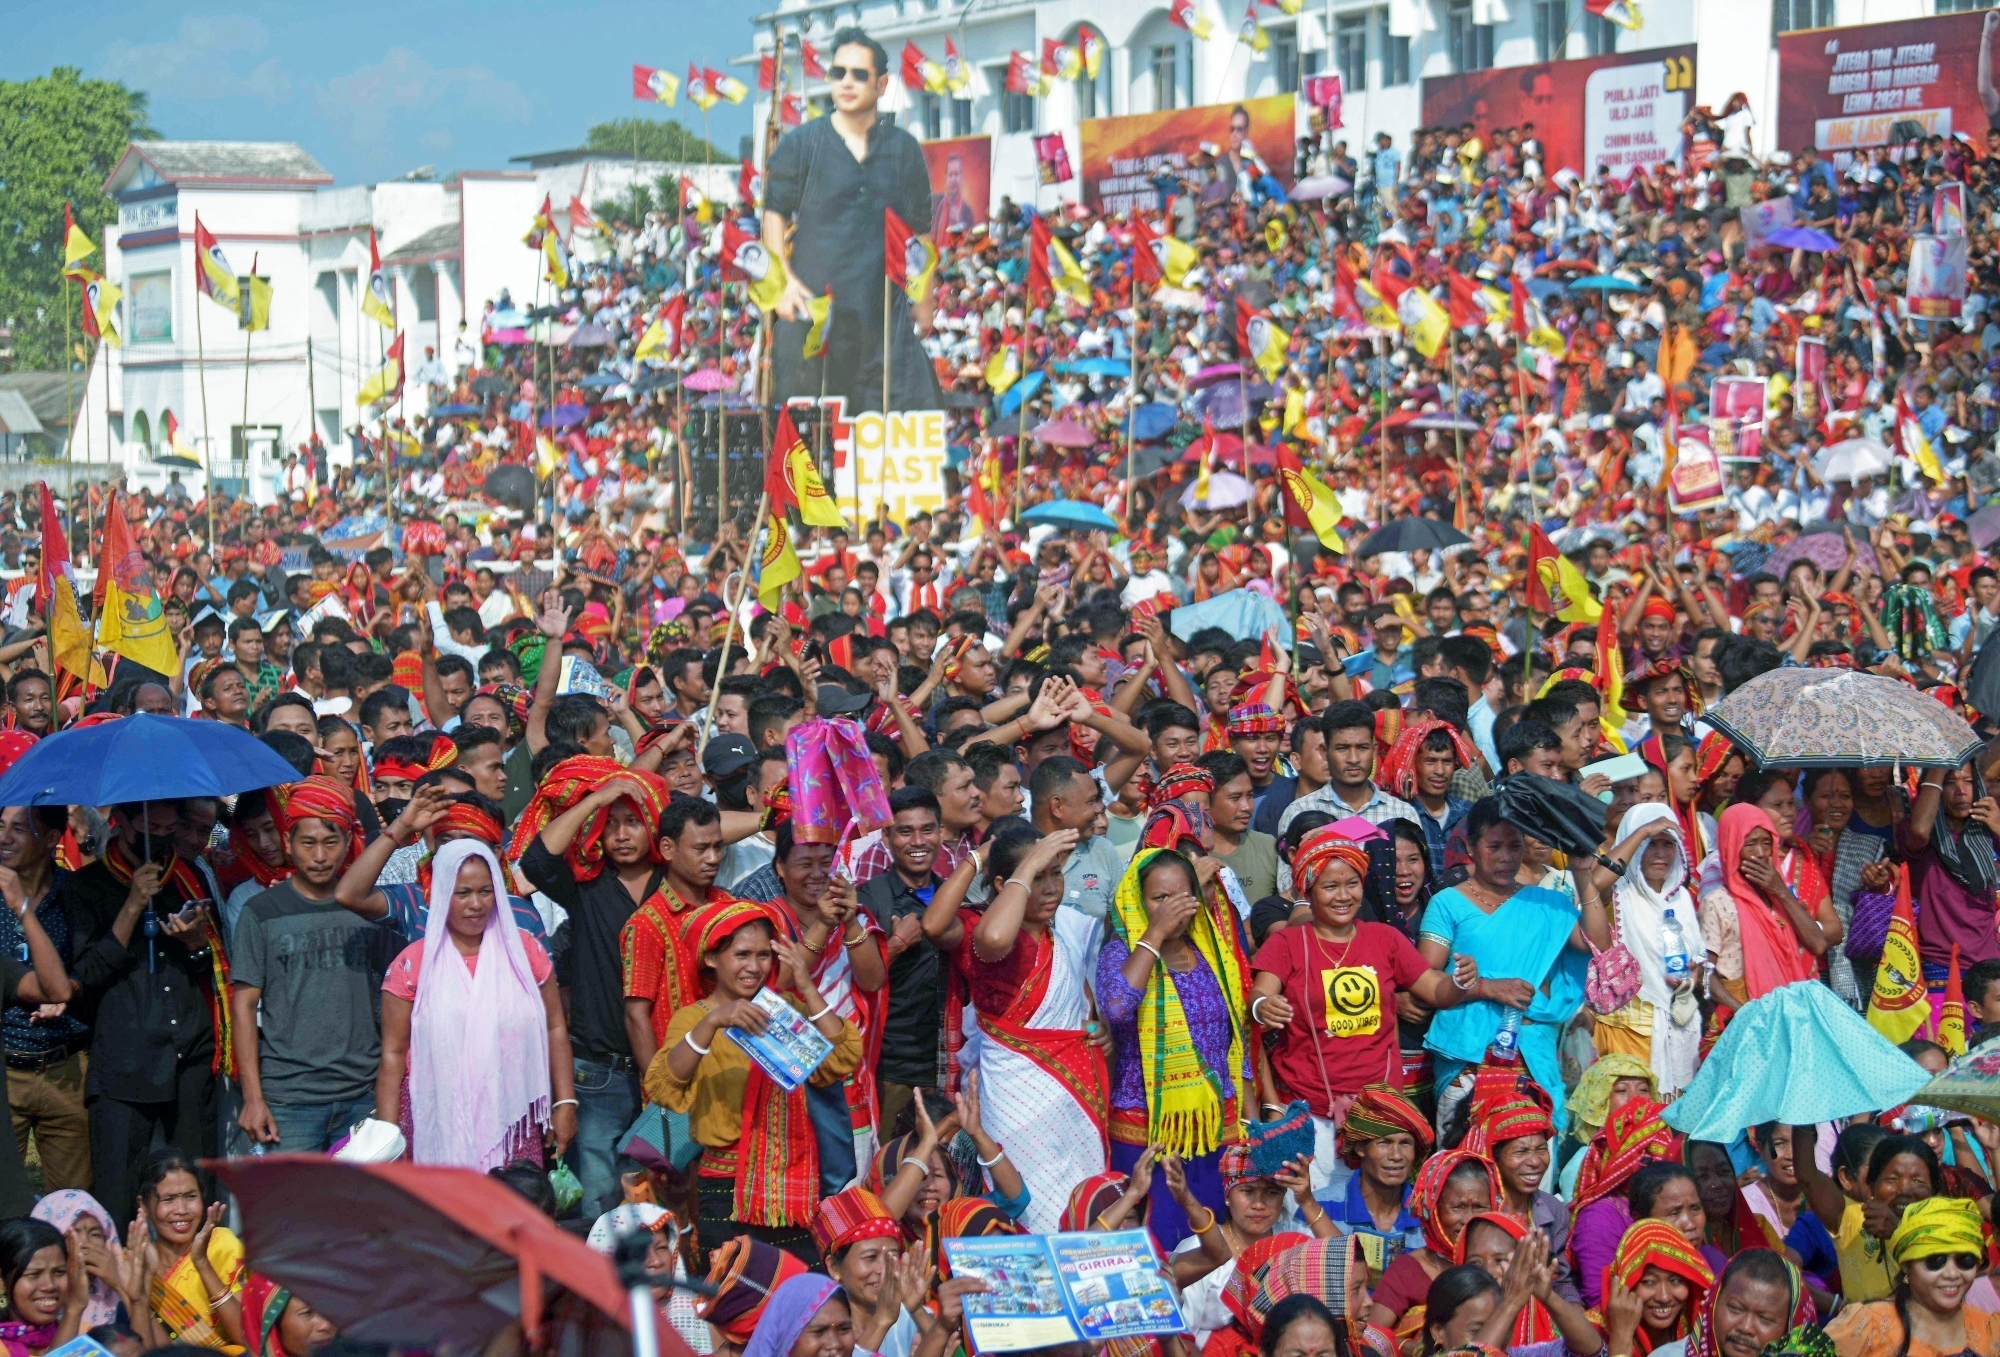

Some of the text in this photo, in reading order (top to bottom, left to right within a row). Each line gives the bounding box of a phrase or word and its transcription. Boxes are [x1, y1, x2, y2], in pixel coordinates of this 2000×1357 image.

[1636, 84, 1659, 100] JATI
[1631, 104, 1653, 119] JATI
[1827, 121, 1857, 146] ONE
[855, 415, 942, 449] ONE
[857, 455, 944, 484] LAST
[1238, 876, 1253, 887] OUS
[1331, 1015, 1379, 1032] GOOD VIBES
[1077, 1256, 1133, 1271] GIRIRAJ
